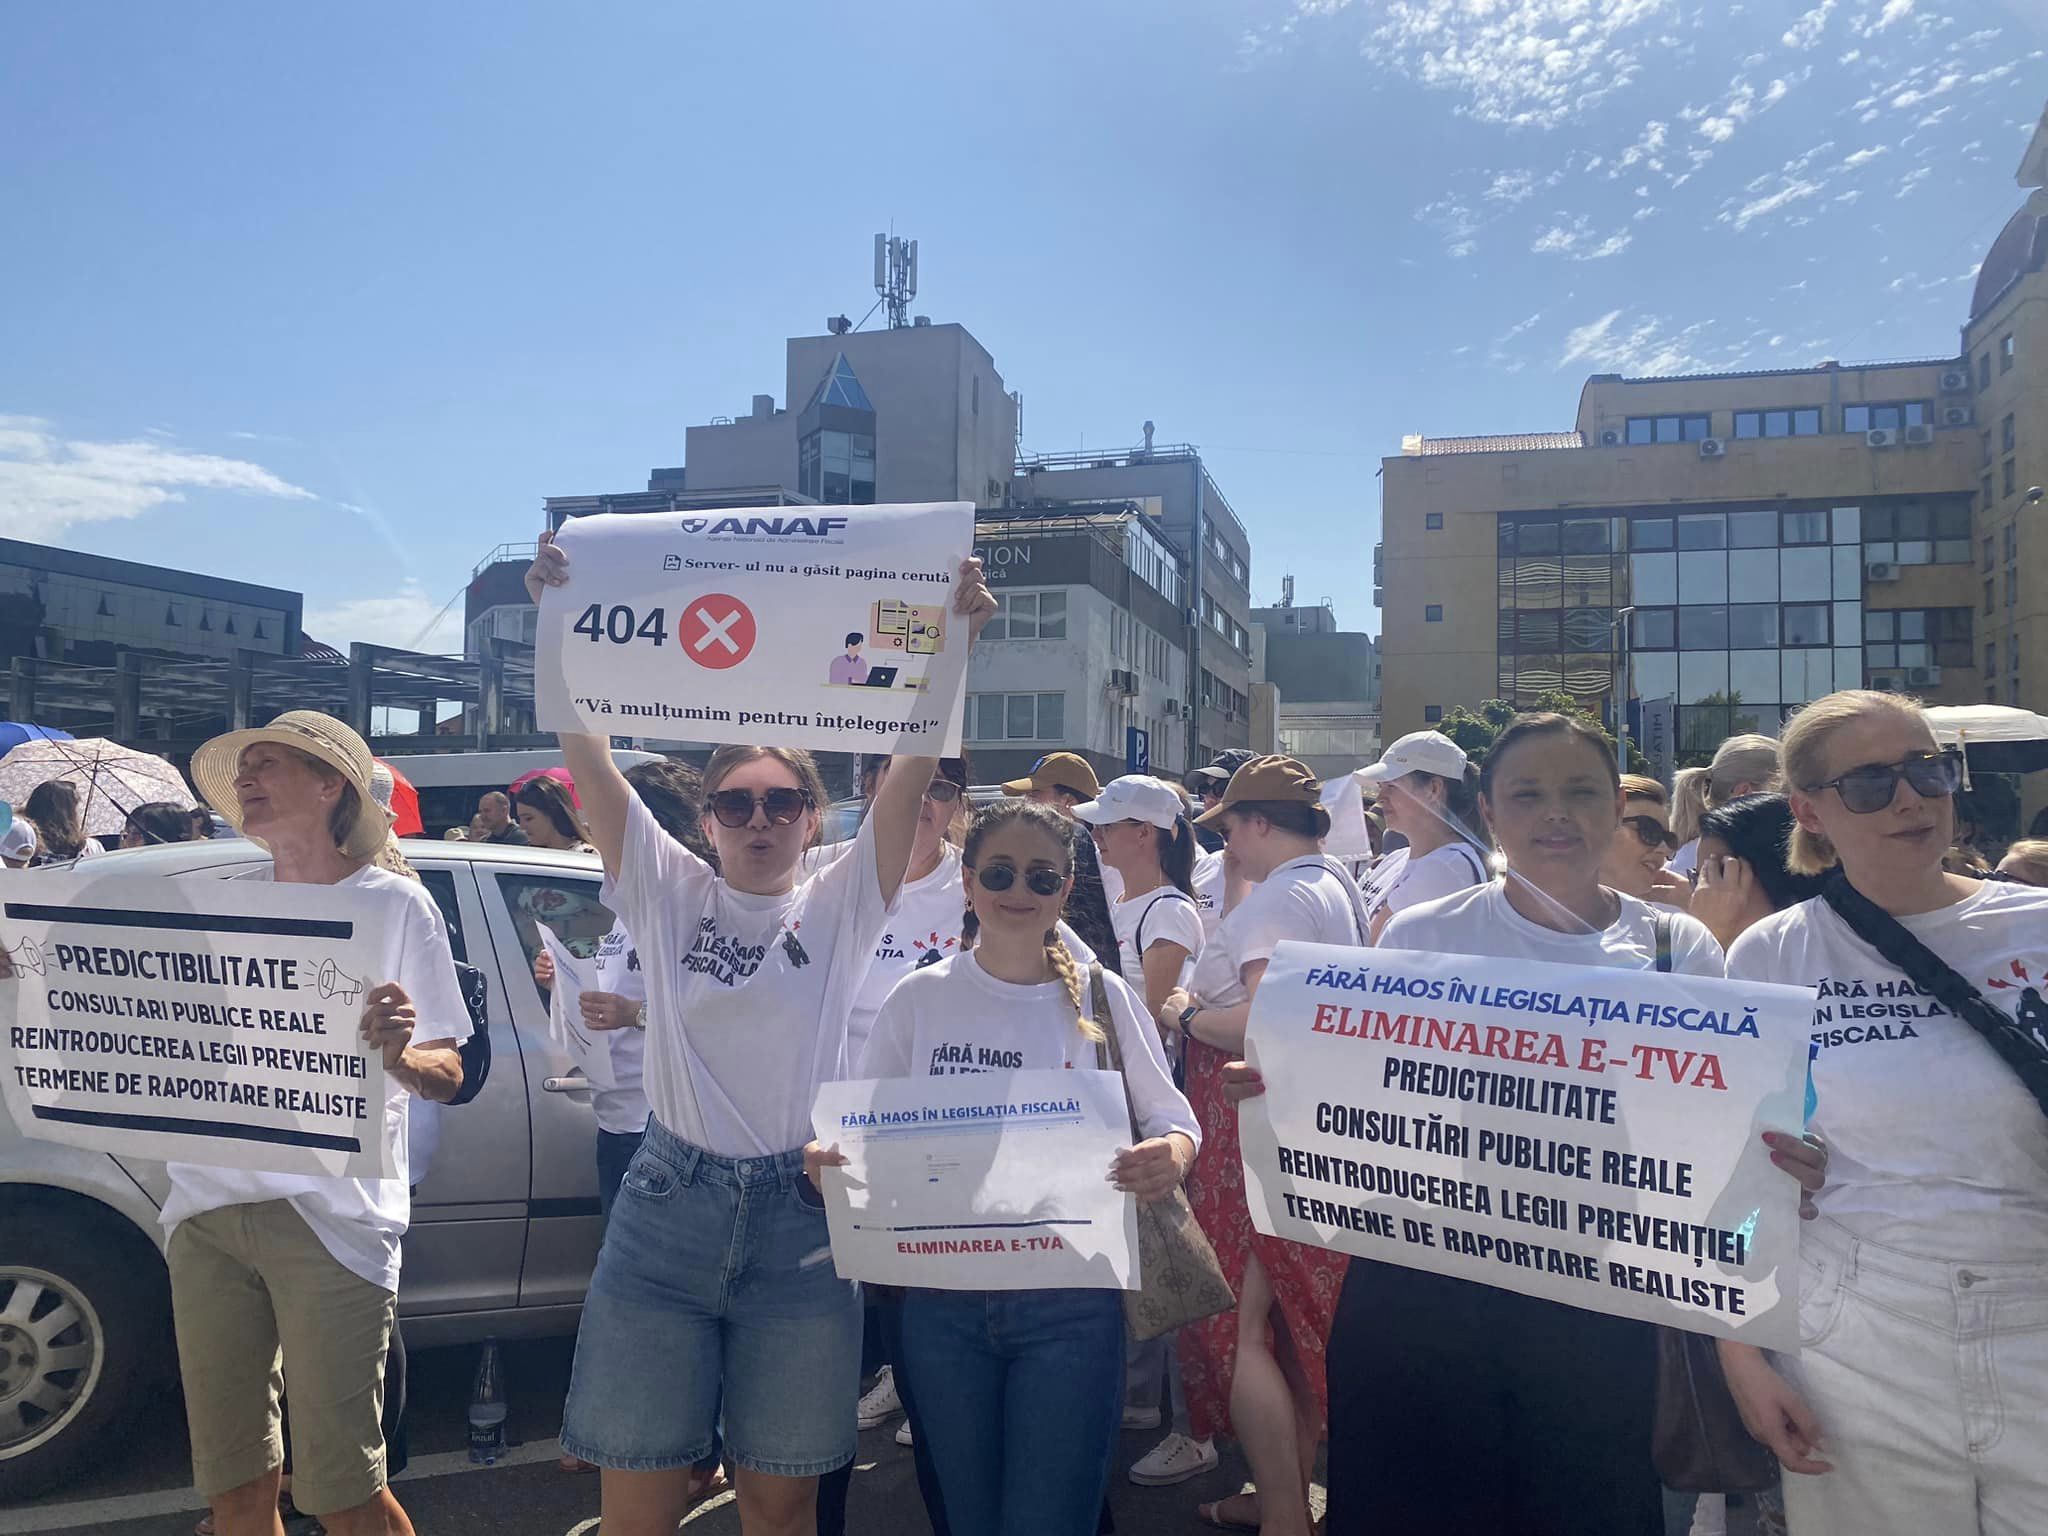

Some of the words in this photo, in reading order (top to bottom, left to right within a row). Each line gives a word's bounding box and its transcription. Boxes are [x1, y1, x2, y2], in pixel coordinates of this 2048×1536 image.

[708, 517, 848, 536] ANAF
[685, 558, 741, 571] Server-
[746, 561, 760, 571] ul
[766, 564, 784, 573] nu
[790, 565, 798, 574] a
[803, 563, 841, 577] găsit
[846, 566, 897, 580] pagina
[902, 569, 950, 584] cerută
[972, 544, 1031, 565] SION
[573, 603, 668, 646] 404
[620, 702, 731, 721] mulțumim
[738, 711, 808, 726] pentru
[703, 936, 759, 977] LEGISLA
[881, 934, 894, 945] S
[55, 943, 299, 990] PREDICTIBILITATE
[1306, 965, 1367, 991] FĂRĂ
[1371, 973, 1443, 1000] HAOS
[1449, 976, 1476, 1005] ÎN
[1480, 985, 1630, 1027] LEGISLAȚIA
[1636, 1002, 1760, 1038] FISCALĂ
[1806, 977, 1869, 1000] ĂRĂ
[1876, 980, 1938, 998] HA
[47, 989, 168, 1021] CONSULTARI
[173, 1005, 254, 1029] PUBLICE
[261, 1009, 327, 1035] REALE
[1840, 1002, 1947, 1019] LEGISLA
[11, 1027, 195, 1061] REINTRODUCEREA
[199, 1041, 248, 1067] LEGII
[253, 1046, 367, 1080] PREVENTIEI
[931, 1042, 974, 1066] FĂRĂ
[978, 1048, 1023, 1068] HAOS
[1312, 1003, 1569, 1068] ELIMINAREA
[1578, 1038, 1728, 1091] E-TVA
[1810, 1021, 1919, 1048] FISCALĂ
[15, 1066, 109, 1094] TERMENE
[116, 1075, 142, 1096] DE
[148, 1075, 269, 1109] RAPORTARE
[275, 1088, 367, 1120] REALISTE
[1383, 1056, 1617, 1124] PREDICTIBILITATE
[841, 1110, 877, 1127] FĂRĂ
[881, 1110, 919, 1124] HAOS
[922, 1106, 938, 1121] ÎN
[942, 1104, 1018, 1120] LEGISLAȚIA
[1021, 1098, 1080, 1115] FISCALĂ!
[1315, 1102, 1468, 1159] CONSULTĂRI
[1479, 1129, 1592, 1181] PUBLICE
[1602, 1153, 1692, 1198] REALE
[1278, 1146, 1492, 1216] REINTRODUCEREA
[1501, 1190, 1567, 1231] LEGII
[1578, 1204, 1745, 1268] PREVENȚIEI
[897, 1237, 1007, 1255] ELIMINAREA
[1011, 1236, 1064, 1252] E-TVA
[1283, 1192, 1396, 1240] TERMENE
[1403, 1217, 1437, 1248] DE
[1445, 1228, 1599, 1283] RAPORTARE
[1609, 1260, 1745, 1316] REALISTE
